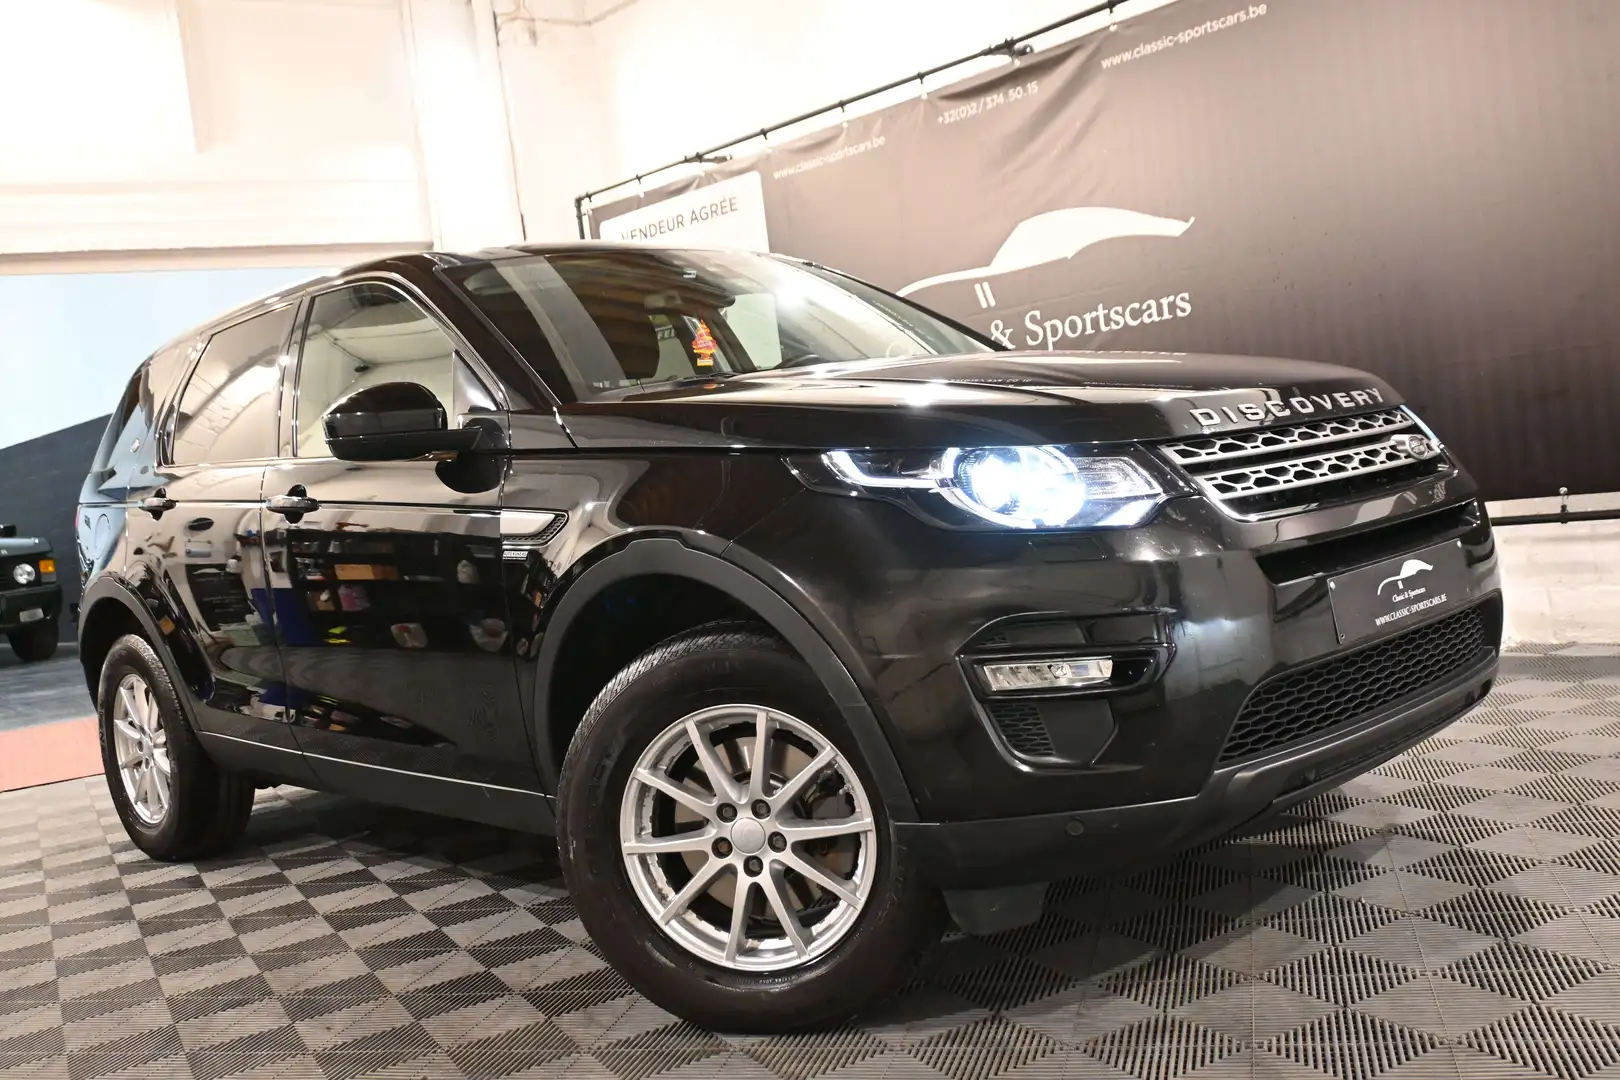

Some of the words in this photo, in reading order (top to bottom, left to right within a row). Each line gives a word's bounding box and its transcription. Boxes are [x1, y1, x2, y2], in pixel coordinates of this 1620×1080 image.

[1101, 3, 1267, 70] www.classic-sportscars.be
[689, 195, 738, 225] AGRÉE
[990, 319, 1016, 350] &
[1024, 292, 1192, 351] Sportscars
[1189, 387, 1384, 427] DISCOVERY
